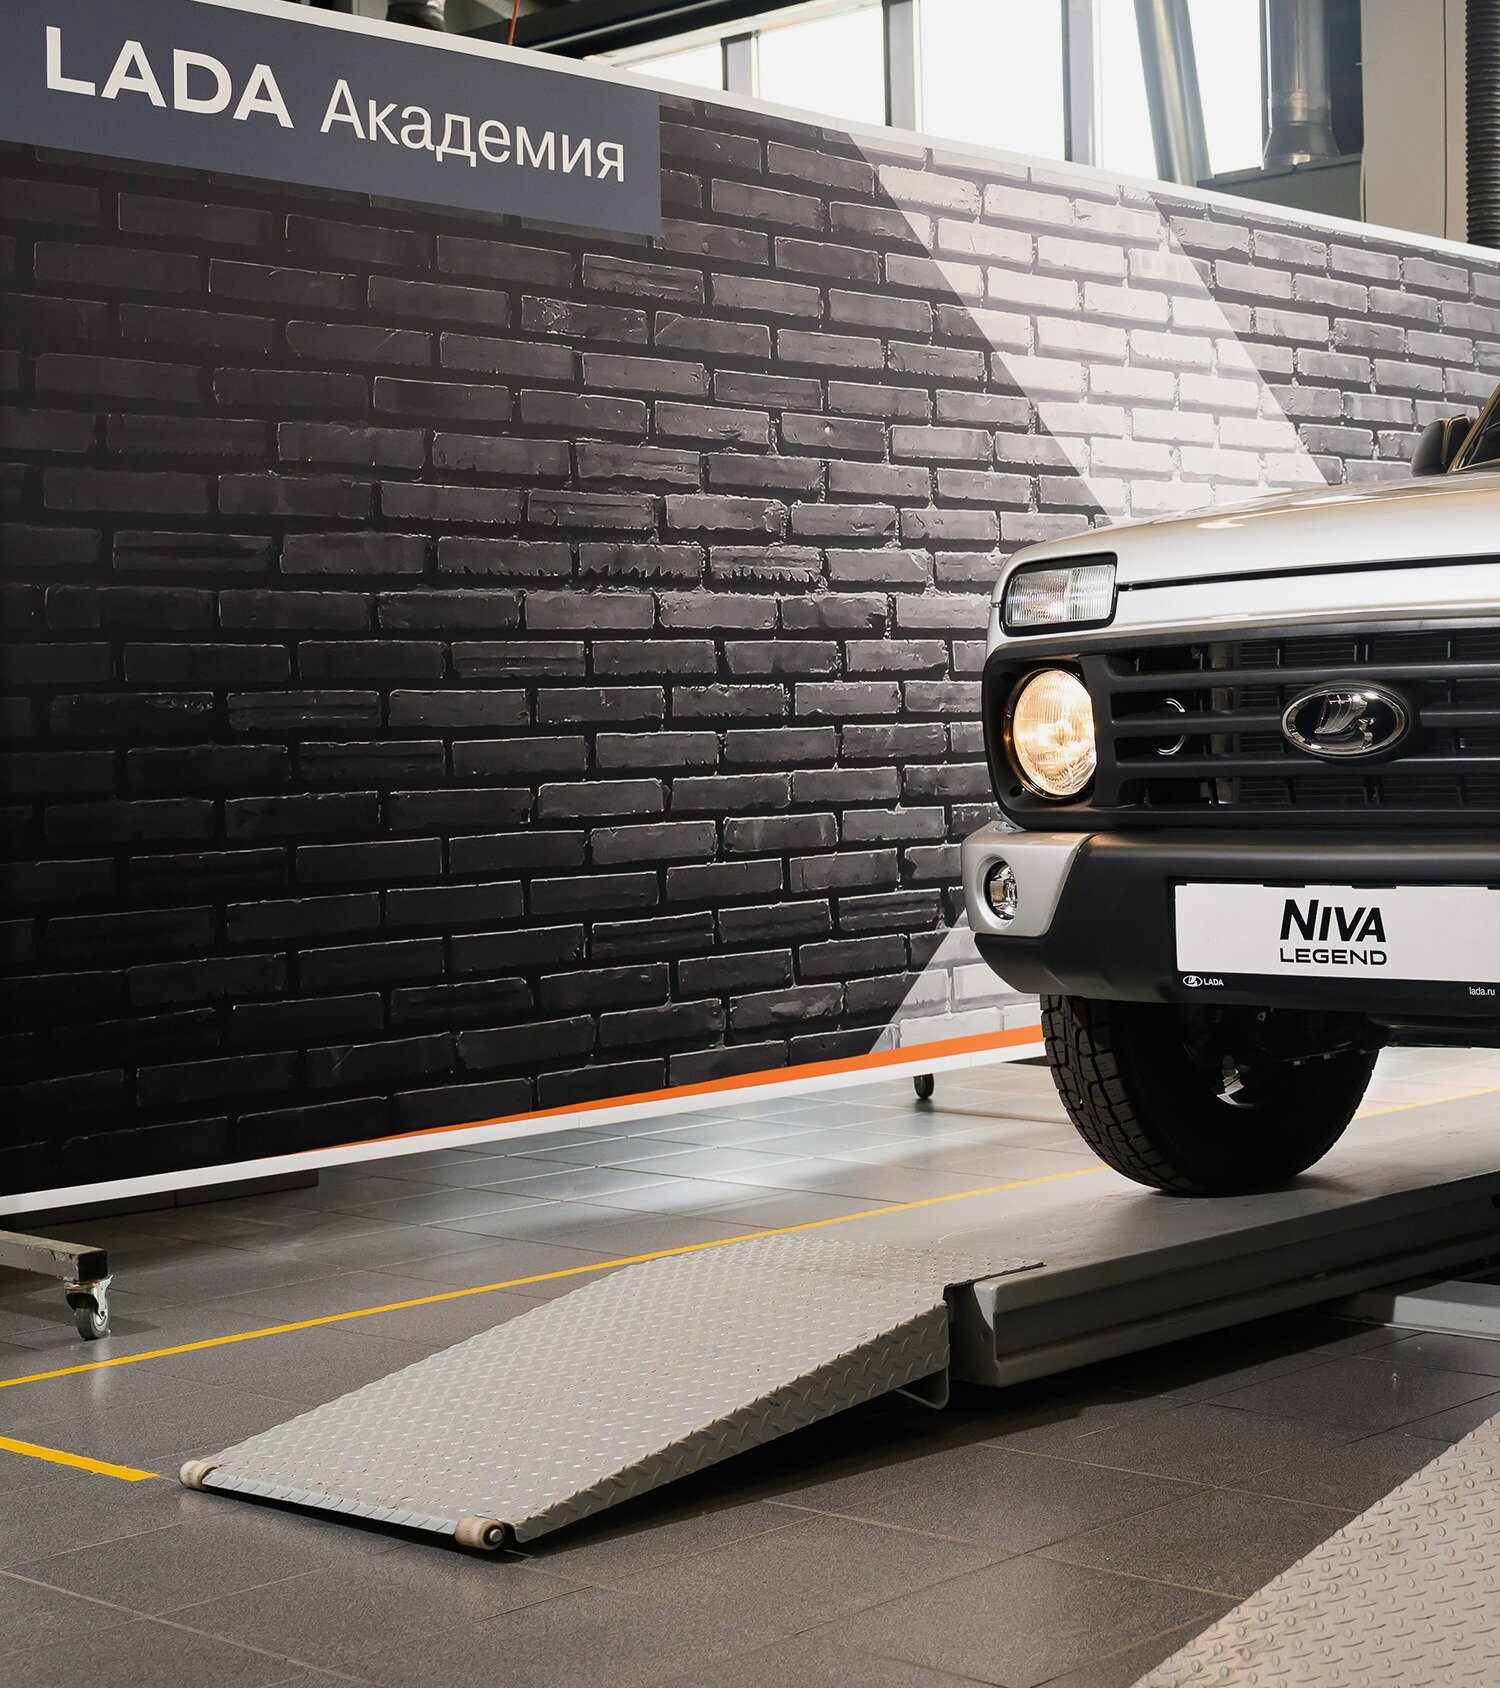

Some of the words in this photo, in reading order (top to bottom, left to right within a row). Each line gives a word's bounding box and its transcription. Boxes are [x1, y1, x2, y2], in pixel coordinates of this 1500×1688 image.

[45, 25, 294, 129] LADA
[320, 79, 625, 182] Академия
[1279, 899, 1386, 943] NIVA
[1280, 948, 1387, 966] LEGEND
[1203, 978, 1224, 987] LADA
[1468, 986, 1496, 997] lada.ru
